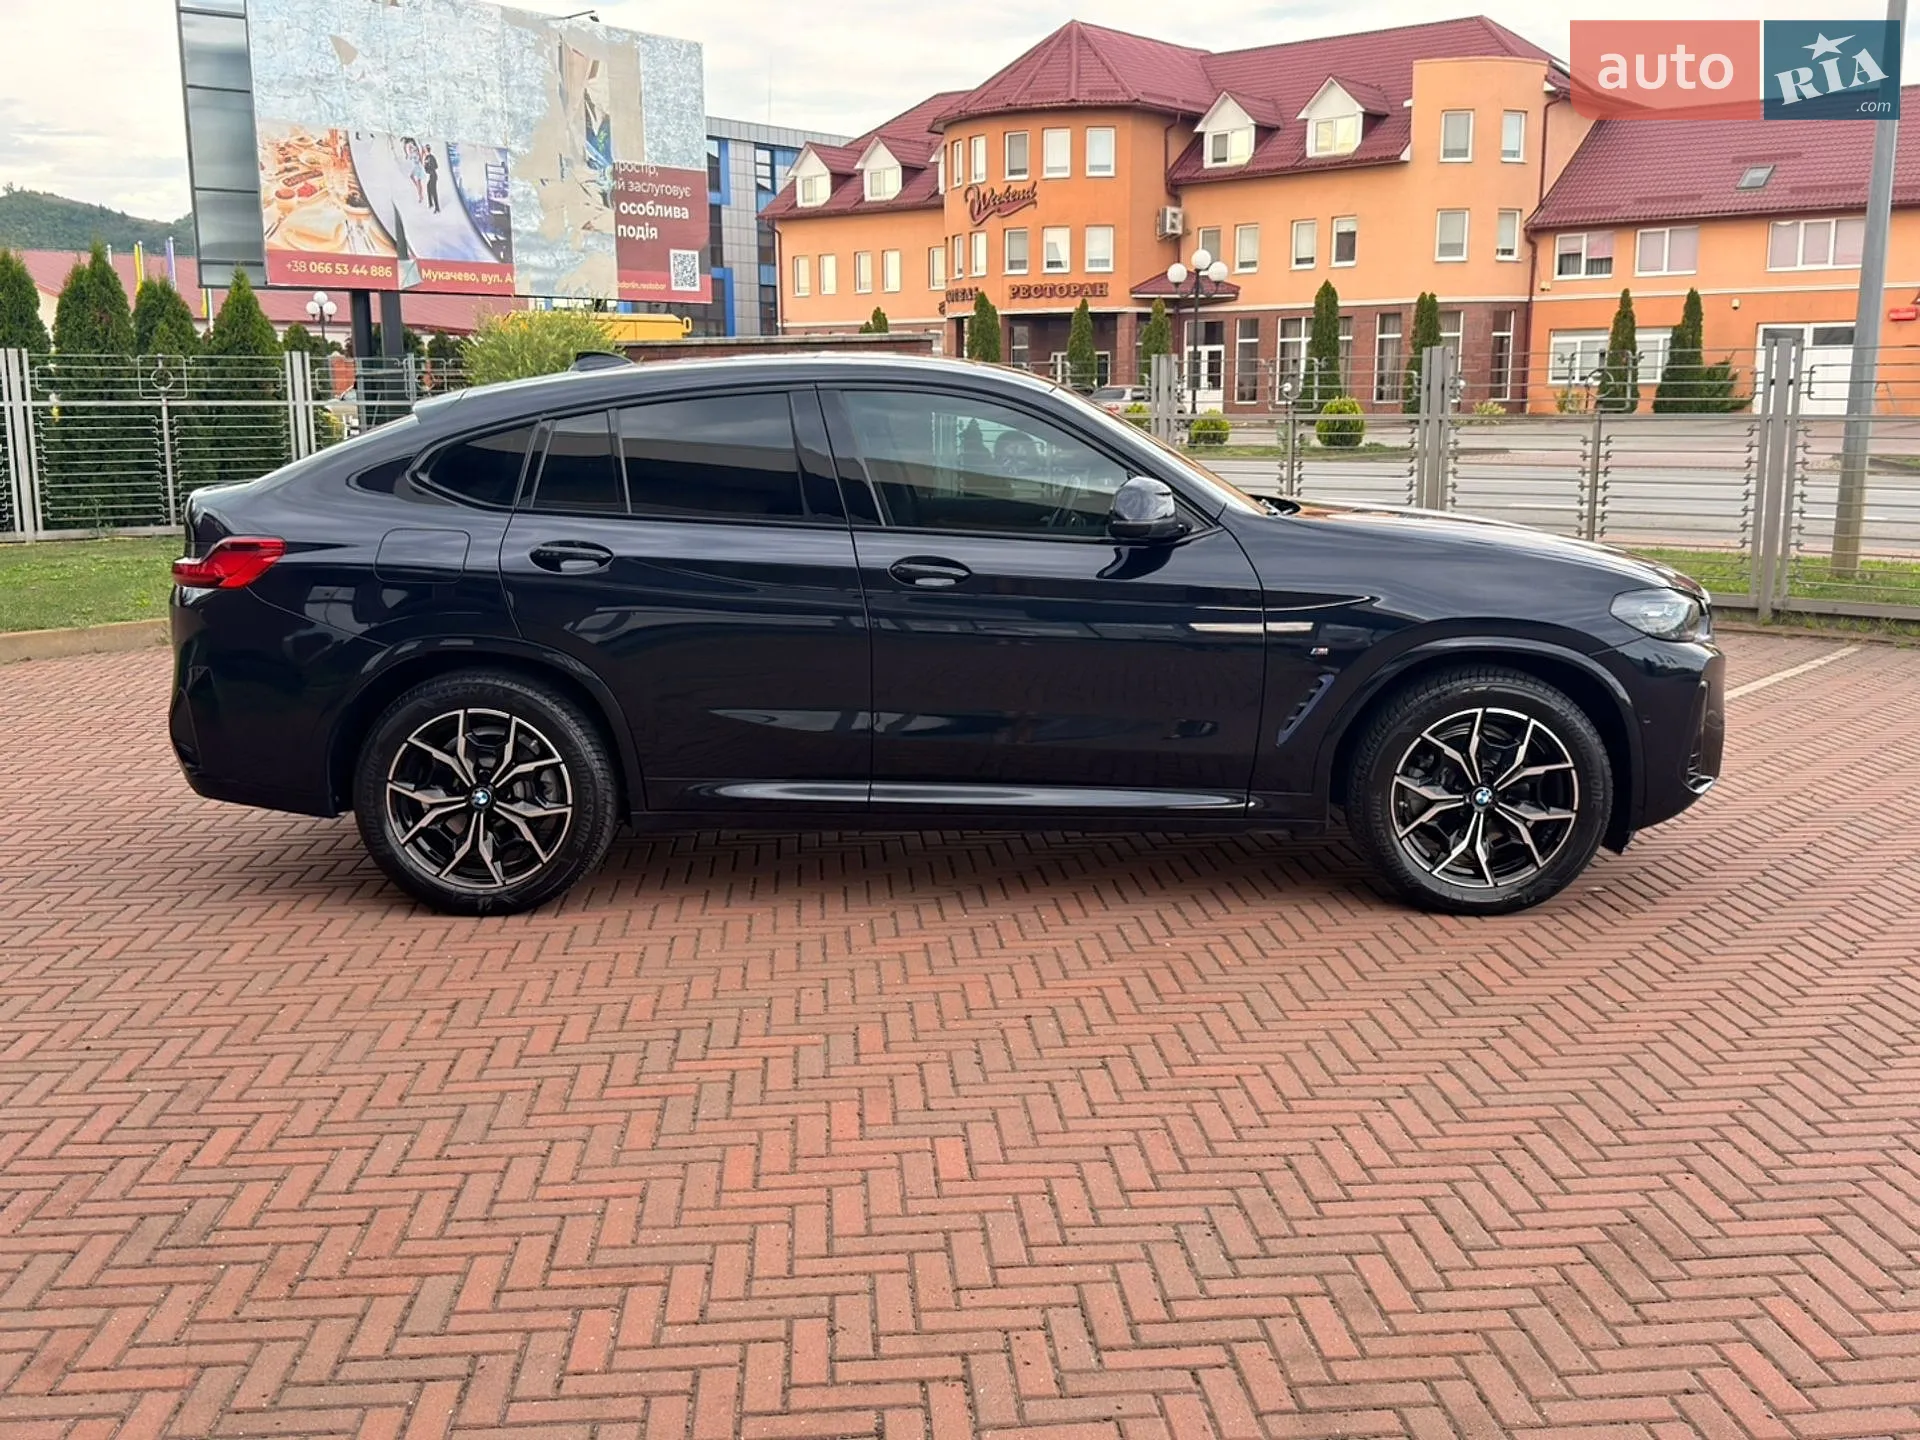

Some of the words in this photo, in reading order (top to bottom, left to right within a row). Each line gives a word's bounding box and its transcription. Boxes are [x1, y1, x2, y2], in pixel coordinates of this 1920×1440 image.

[628, 180, 692, 199] заслуговує
[620, 201, 690, 220] особлива
[965, 181, 1038, 222] Weekend
[617, 222, 659, 240] подія
[286, 260, 307, 273] +38
[309, 261, 333, 275] 066
[335, 262, 349, 275] 53
[351, 263, 369, 276] 44
[370, 265, 393, 278] 886
[421, 267, 480, 284] Мукачево,
[481, 273, 503, 285] вул.
[1009, 282, 1109, 300] РЕСТОРАН
